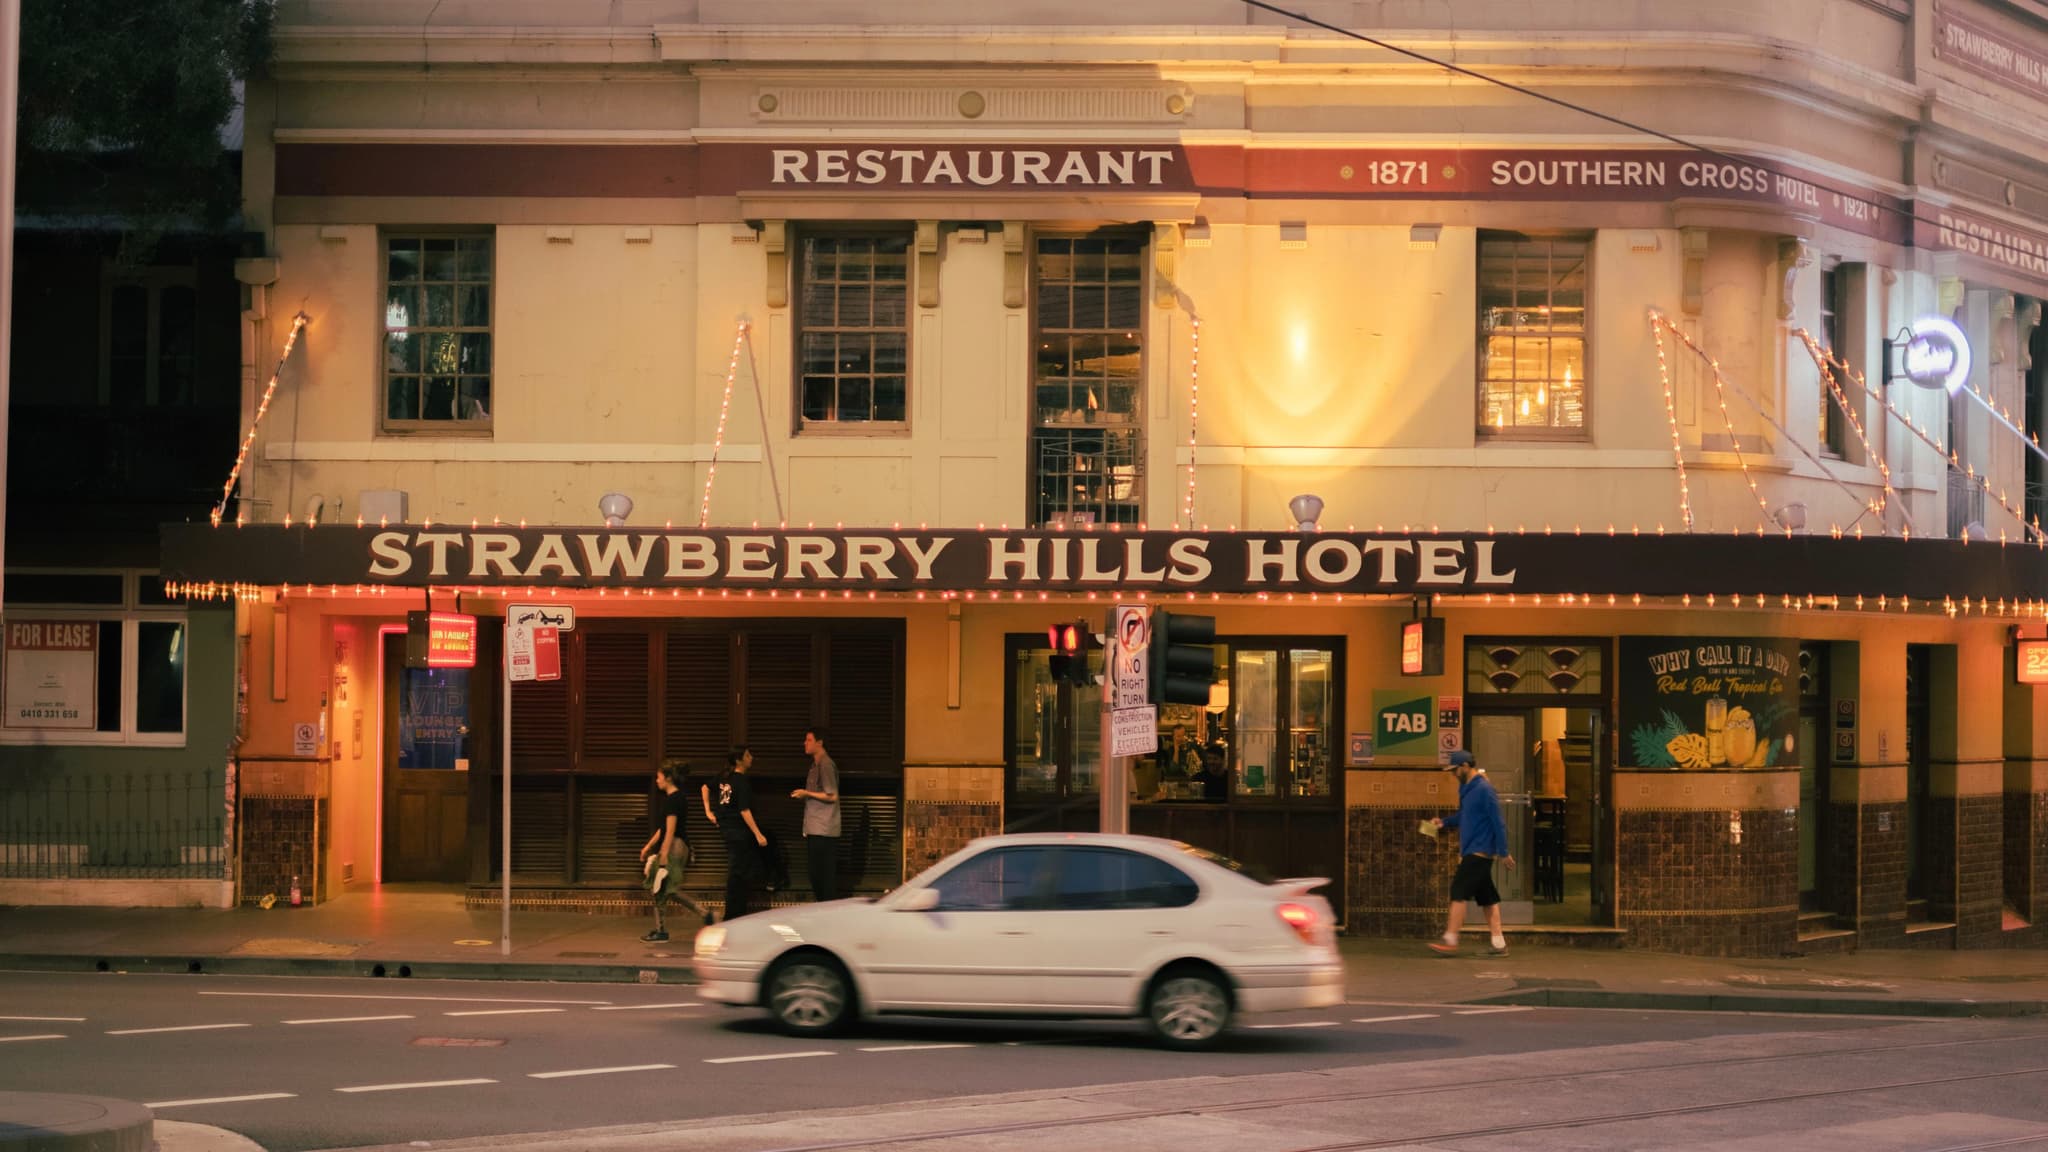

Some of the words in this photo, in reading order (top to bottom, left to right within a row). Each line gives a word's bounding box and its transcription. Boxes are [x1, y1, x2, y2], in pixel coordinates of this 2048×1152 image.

[1946, 23, 2014, 71] STRAWBERRY
[2015, 53, 2040, 83] HILLS
[771, 150, 1174, 185] RESTAURANT
[1368, 161, 1428, 185] 1871
[1491, 160, 1665, 186] SOUTHERN
[1679, 164, 1768, 193] CROSS
[1776, 175, 1820, 206] HOTEL
[1843, 196, 1868, 221] 1921
[1938, 213, 2048, 274] RESTAURA
[368, 532, 954, 580] STRAWBERRY
[987, 537, 1213, 583] HILLS
[1246, 538, 1517, 583] HOTEL
[12, 624, 41, 647] FOR
[46, 624, 91, 647] LEASE
[1124, 657, 1141, 674] NO
[1648, 649, 1691, 675] WHY
[1696, 645, 1733, 667] CALL
[1737, 645, 1752, 666] IT
[1754, 648, 1763, 667] A
[1121, 679, 1144, 690] RIGHT
[1657, 675, 1688, 694] Red
[1691, 675, 1722, 696] Bull
[1724, 676, 1768, 699] Tropical
[407, 690, 465, 714] VIP
[1123, 694, 1144, 705] TURN
[21, 709, 42, 718] 0410
[405, 714, 464, 728] LOUNGE
[1114, 713, 1153, 725] CONSTRUCTION
[1382, 713, 1427, 733] TAB
[1117, 725, 1150, 736] VEHICLES
